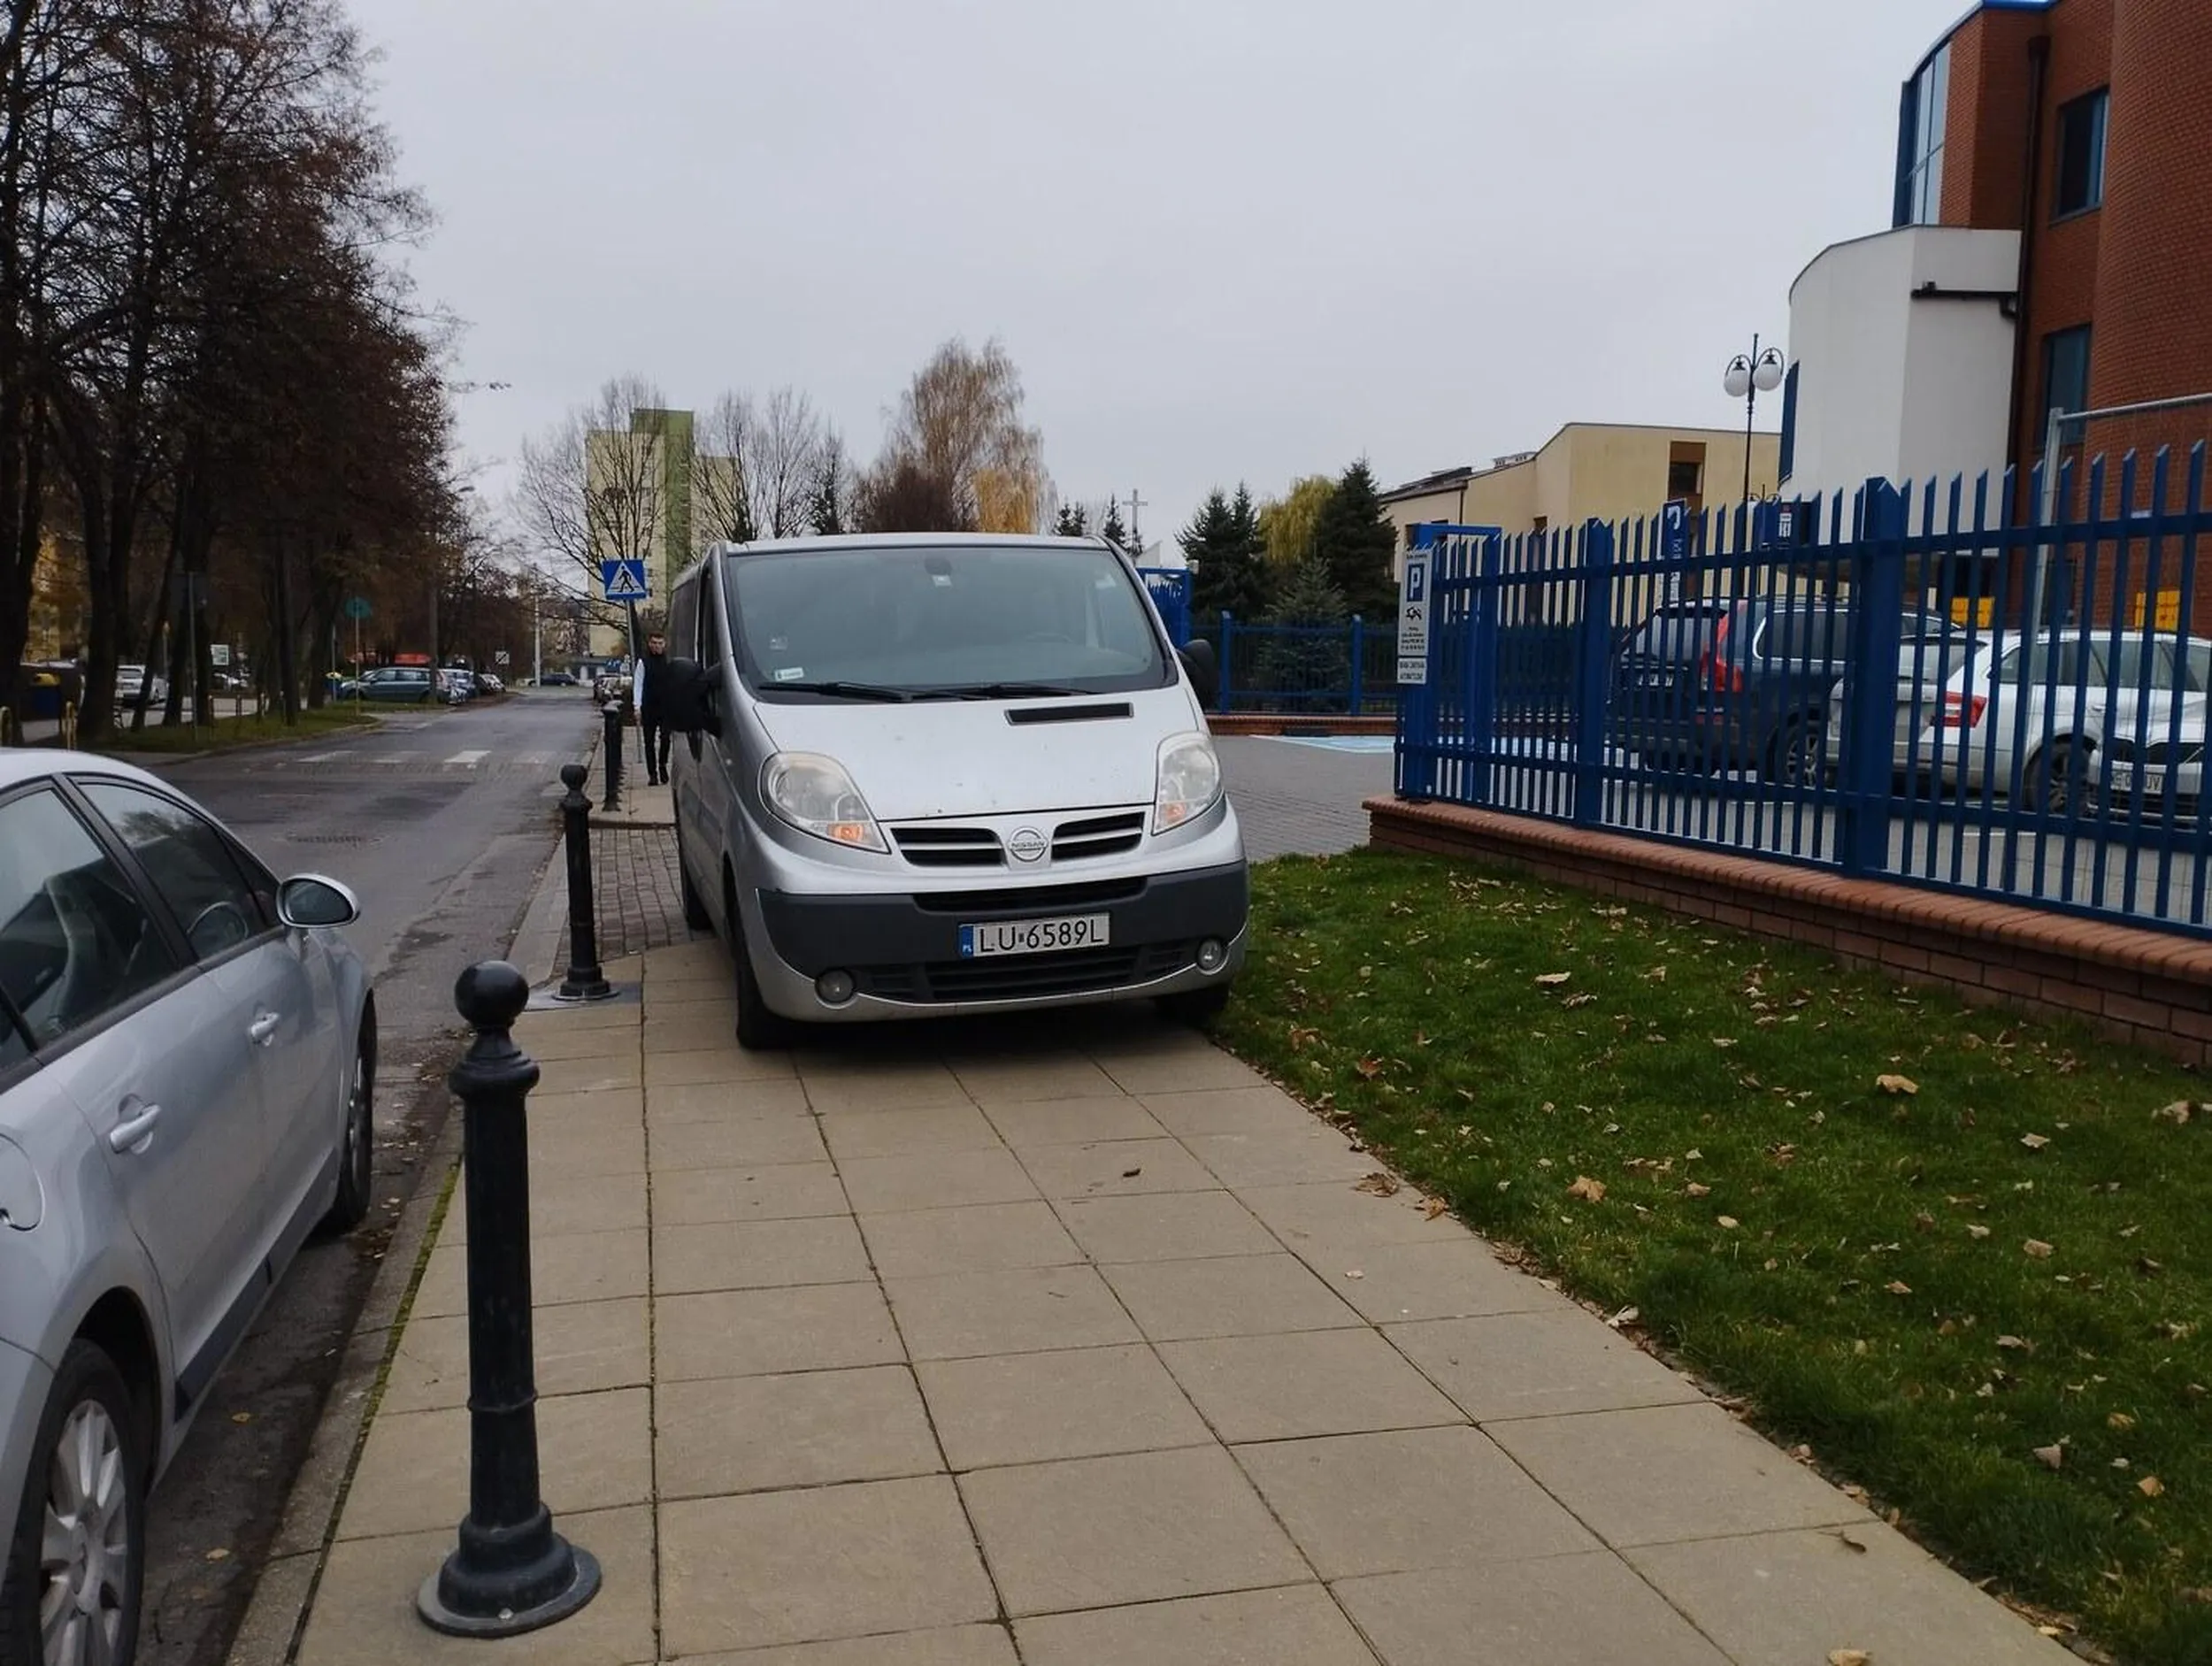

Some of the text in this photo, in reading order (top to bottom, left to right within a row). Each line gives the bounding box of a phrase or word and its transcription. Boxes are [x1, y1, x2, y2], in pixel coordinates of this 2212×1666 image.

[1409, 566, 1421, 600] P
[979, 918, 1104, 953] LU 6589L
